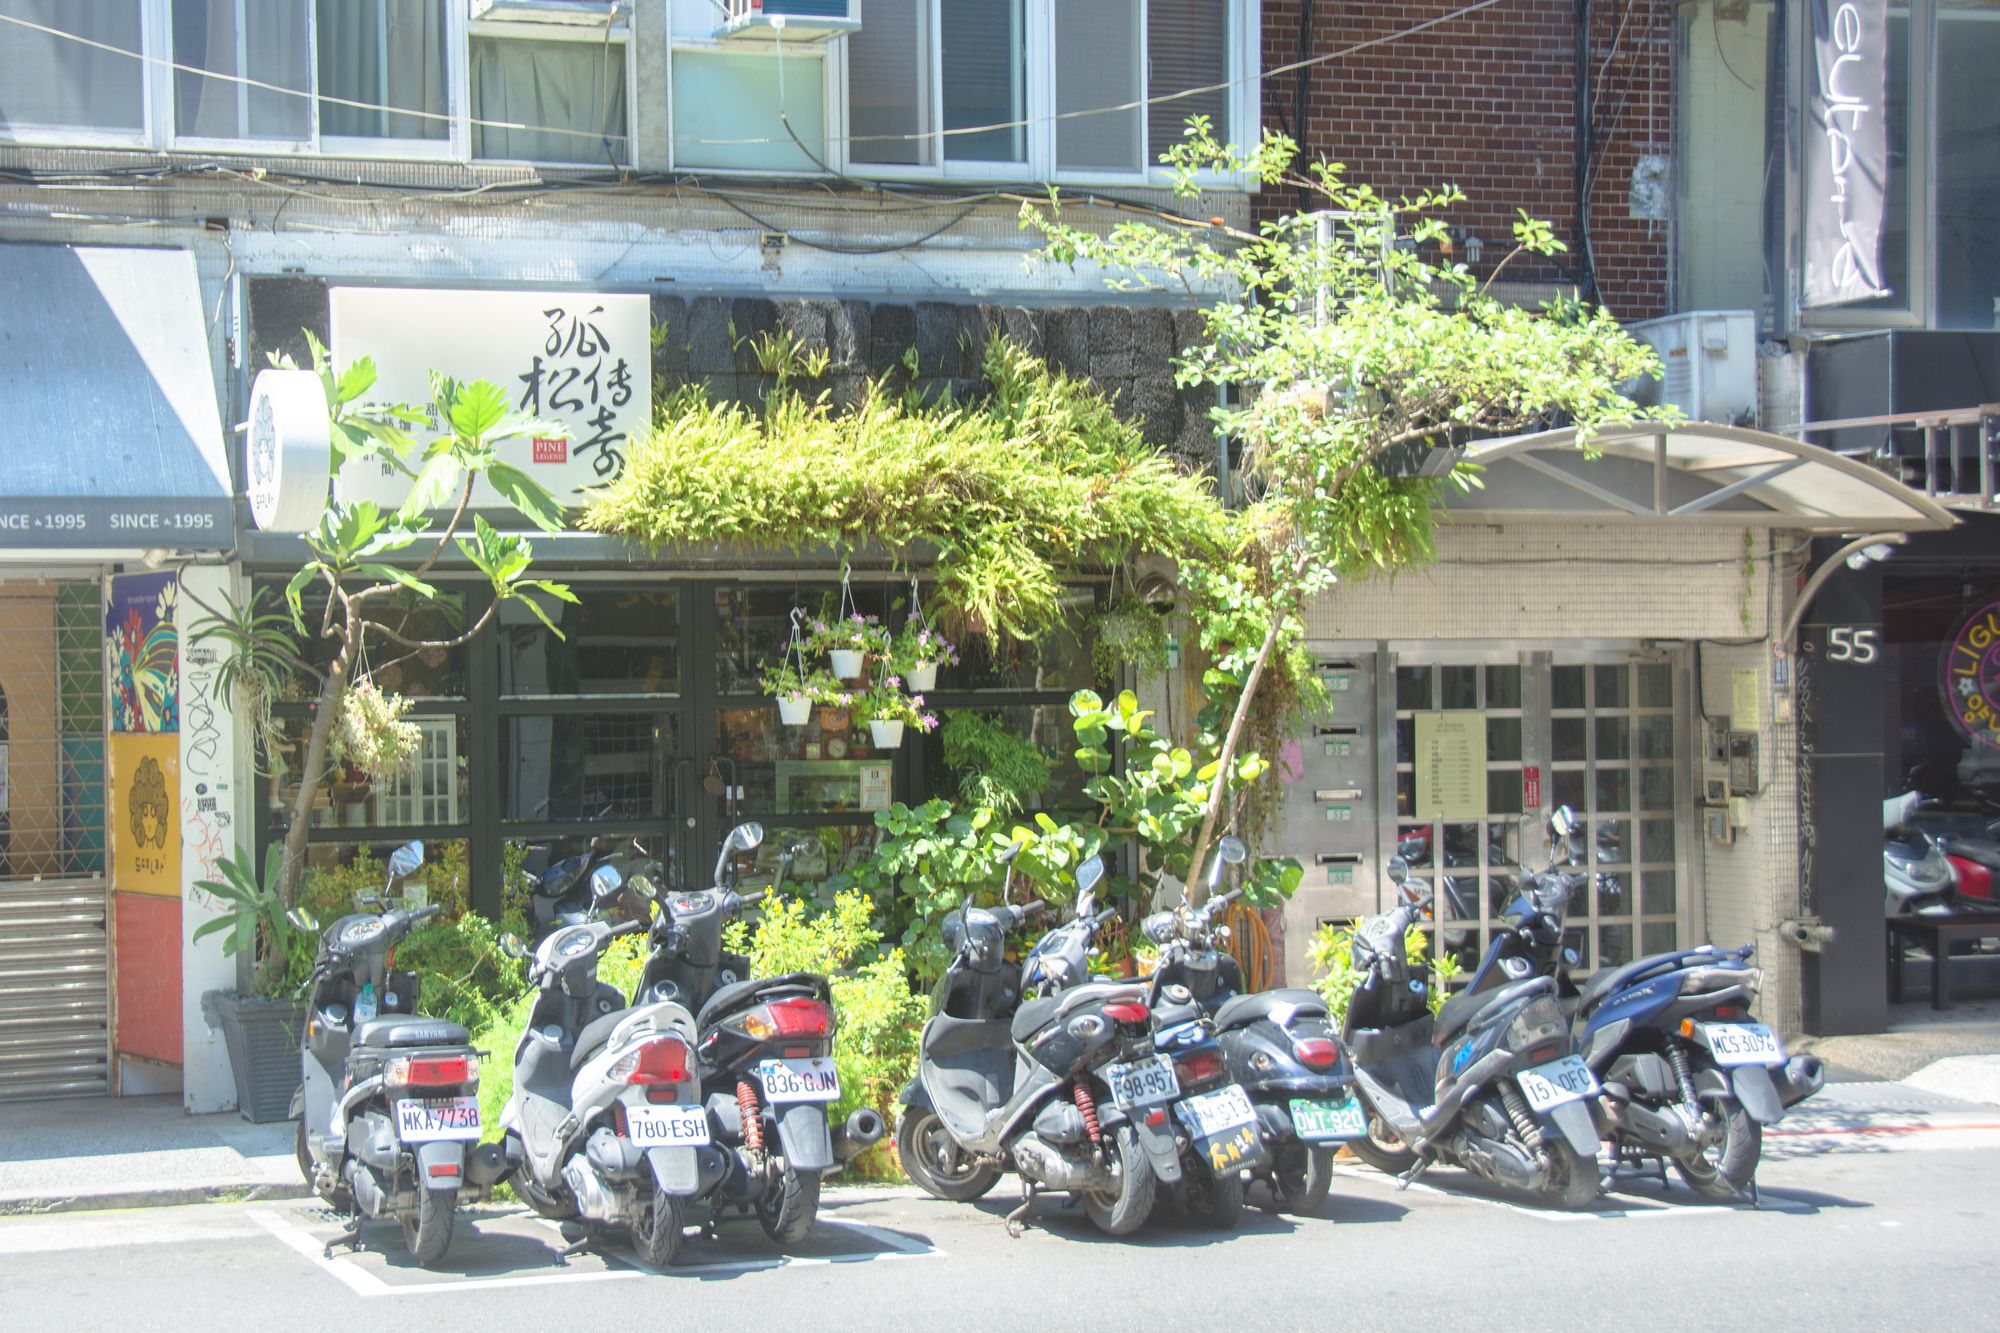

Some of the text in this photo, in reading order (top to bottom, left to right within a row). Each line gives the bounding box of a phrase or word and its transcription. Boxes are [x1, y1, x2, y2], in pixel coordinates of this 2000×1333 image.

[536, 442, 564, 452] PINE
[535, 453, 564, 461] LEGEND
[44, 514, 87, 529] 1995
[110, 513, 214, 529] SINCE 1995
[1828, 627, 1875, 664] 55
[415, 1030, 448, 1039] SANYANG
